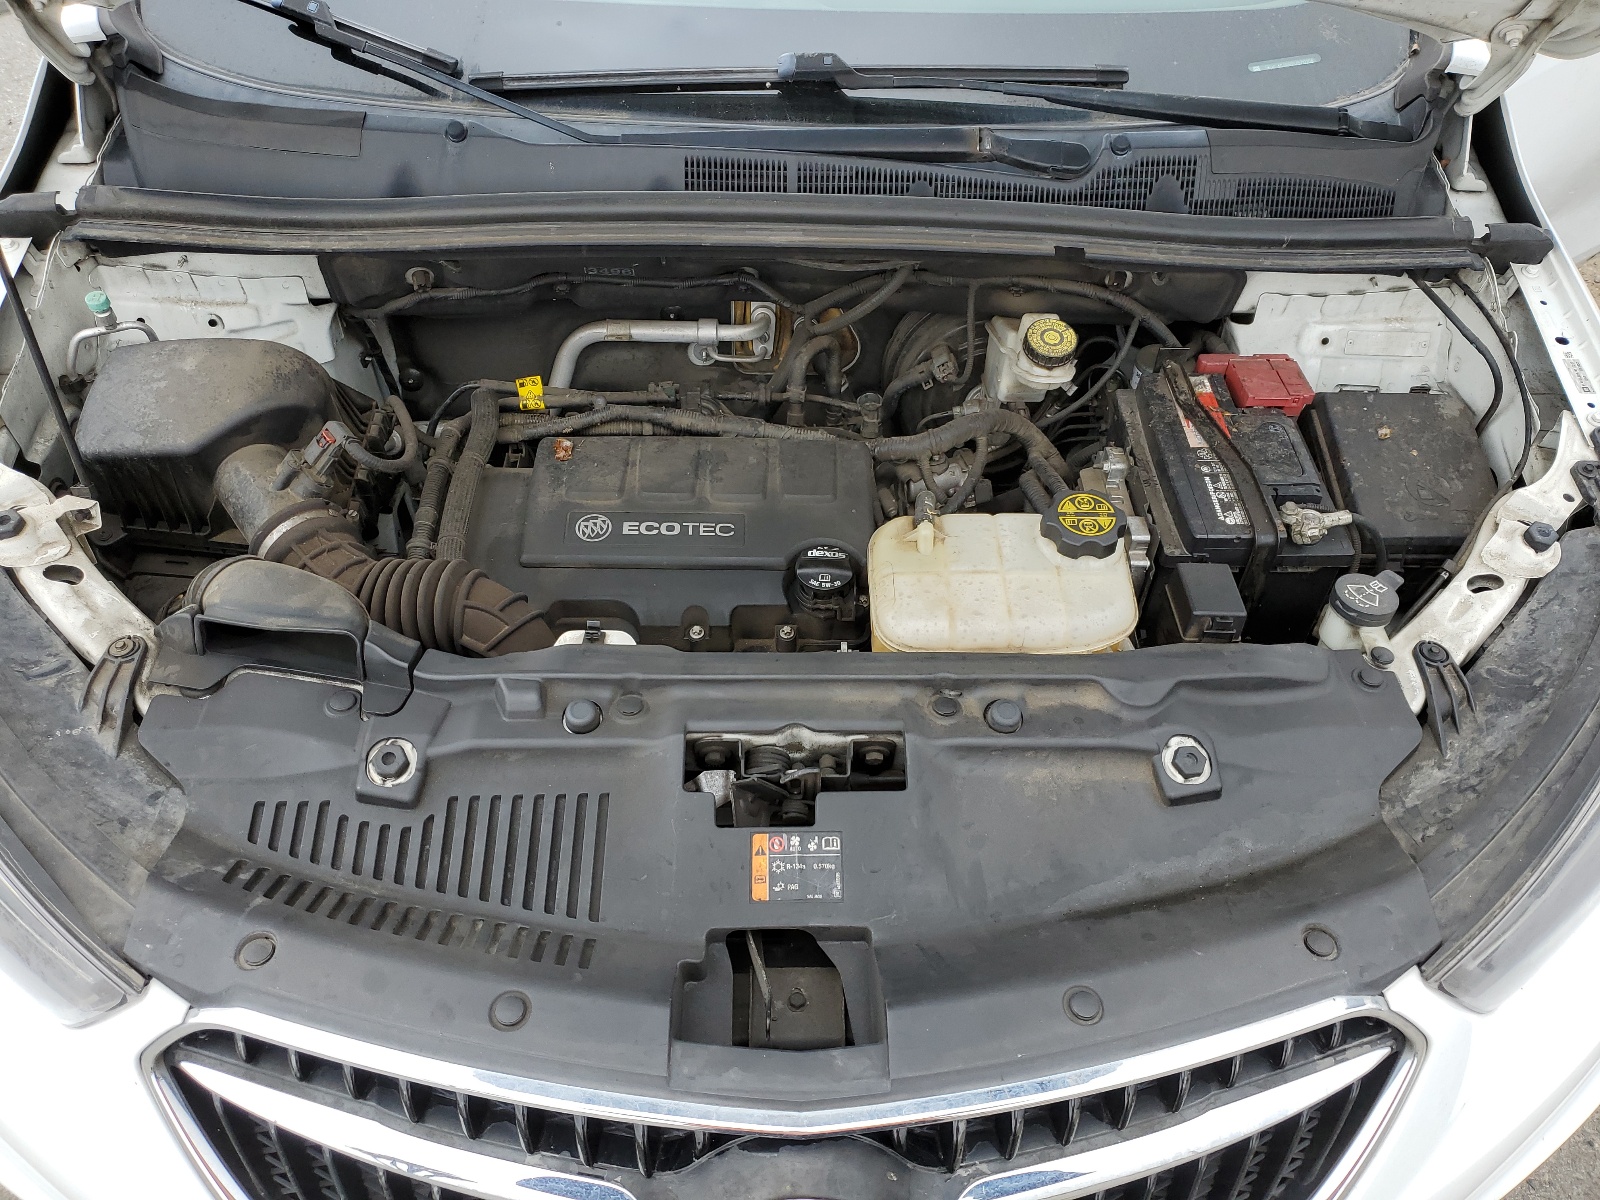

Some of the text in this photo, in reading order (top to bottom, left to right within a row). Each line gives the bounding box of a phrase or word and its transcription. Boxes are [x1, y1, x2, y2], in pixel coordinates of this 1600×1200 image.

[622, 521, 735, 537] ECOTEC
[807, 549, 846, 559] dexos
[808, 578, 841, 588] SAE 5W-30
